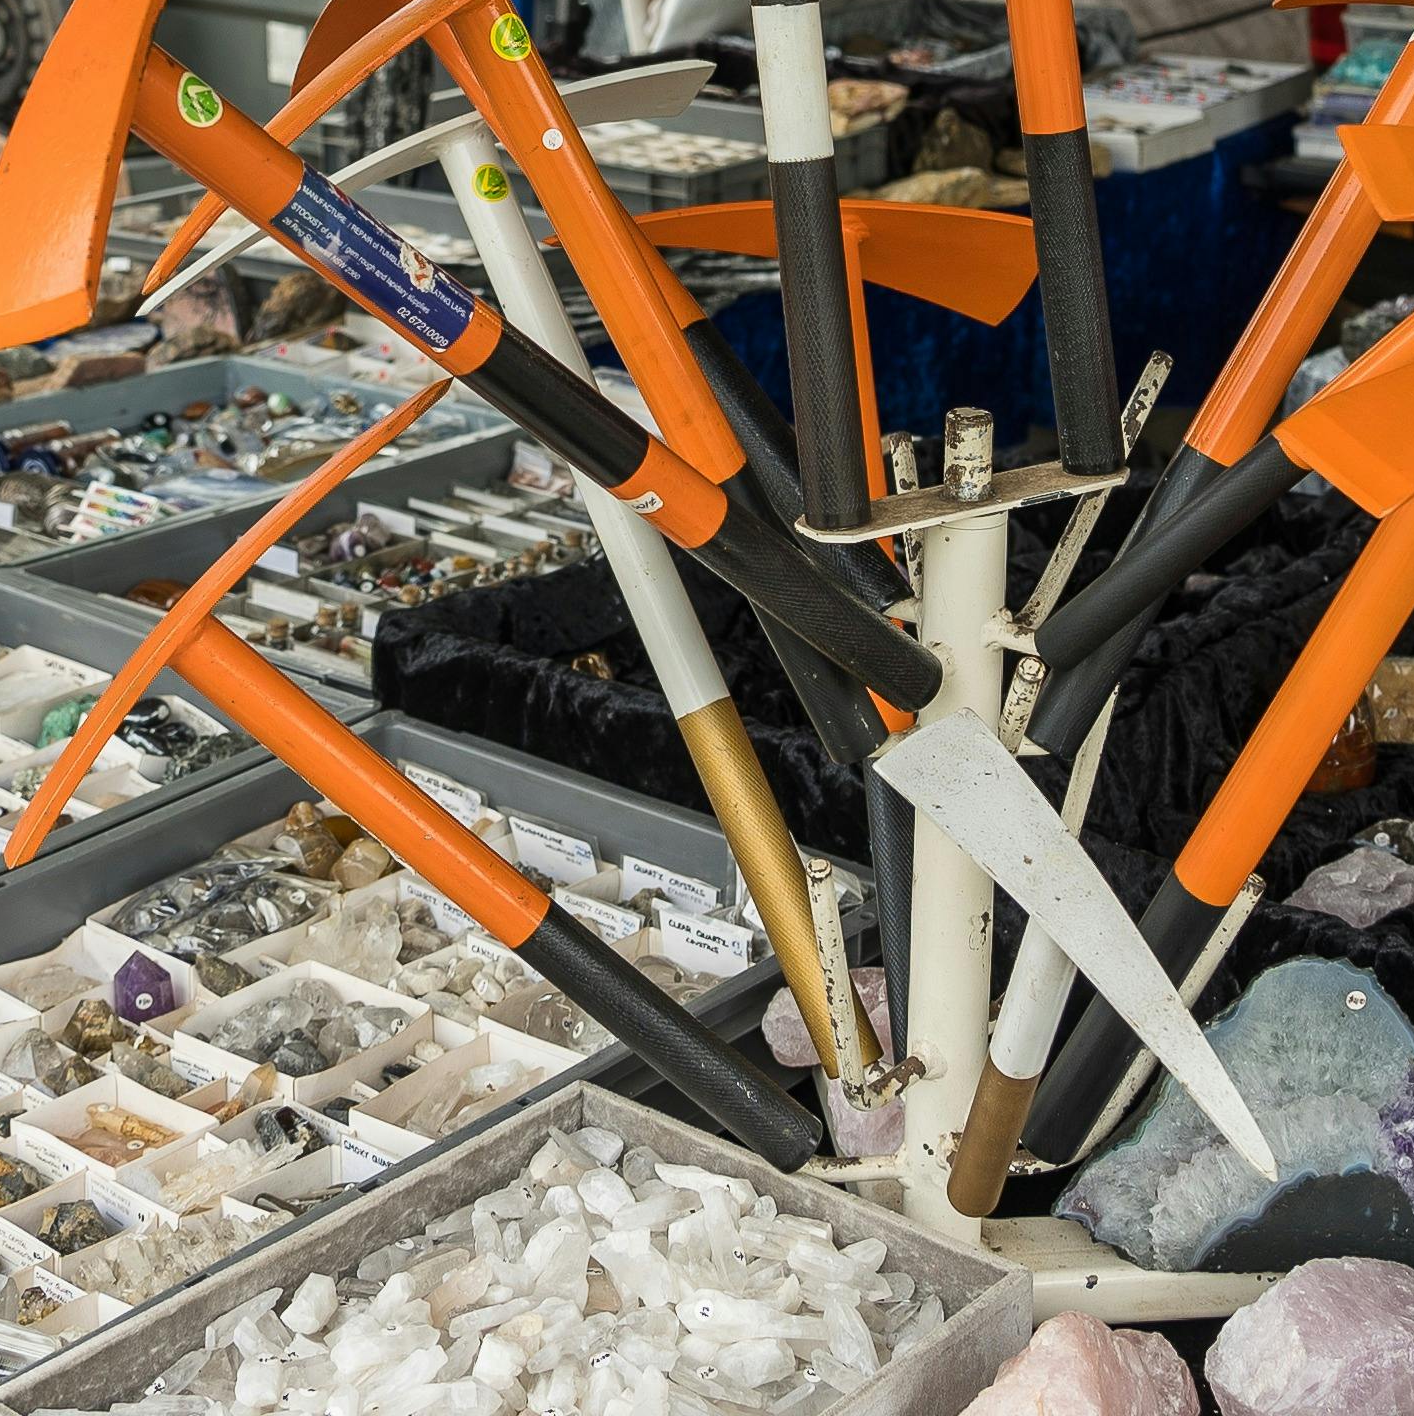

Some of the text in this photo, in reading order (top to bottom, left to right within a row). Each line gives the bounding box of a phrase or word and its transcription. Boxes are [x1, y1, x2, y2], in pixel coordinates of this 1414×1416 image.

[290, 202, 323, 230] STOCKIST
[302, 185, 347, 225] MANUFACTURE
[396, 306, 409, 321] 02
[668, 877, 707, 898] CRYSTALS
